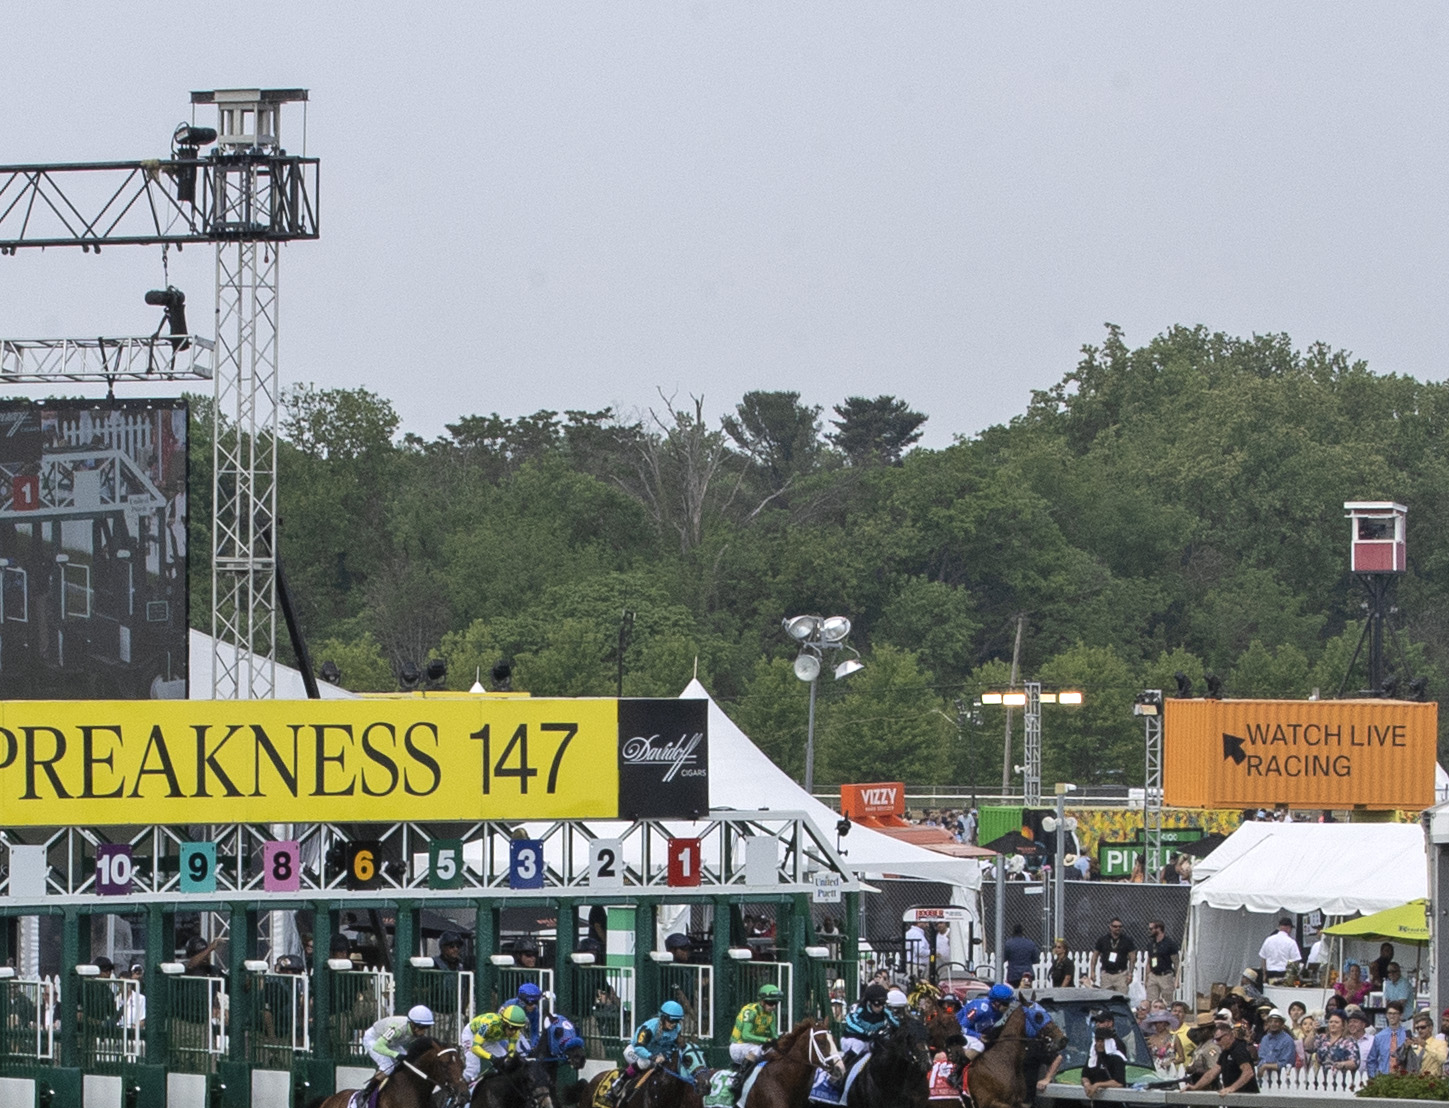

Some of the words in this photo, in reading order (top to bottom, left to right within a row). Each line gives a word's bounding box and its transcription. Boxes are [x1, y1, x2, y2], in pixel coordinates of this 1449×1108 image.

[20, 483, 32, 503] 1
[1246, 724, 1341, 747] WATCH
[1352, 725, 1407, 747] LIVE
[470, 722, 579, 795] 147
[622, 733, 703, 782] Davidoff
[1247, 755, 1351, 777] RACING
[861, 788, 897, 805] VIZZY
[97, 854, 131, 885] 10
[189, 852, 208, 882] 9
[272, 851, 292, 881] 8
[354, 850, 374, 880] 6
[436, 850, 456, 880] 5
[517, 849, 537, 879] 3
[597, 849, 615, 877] 2
[678, 848, 690, 876] 1
